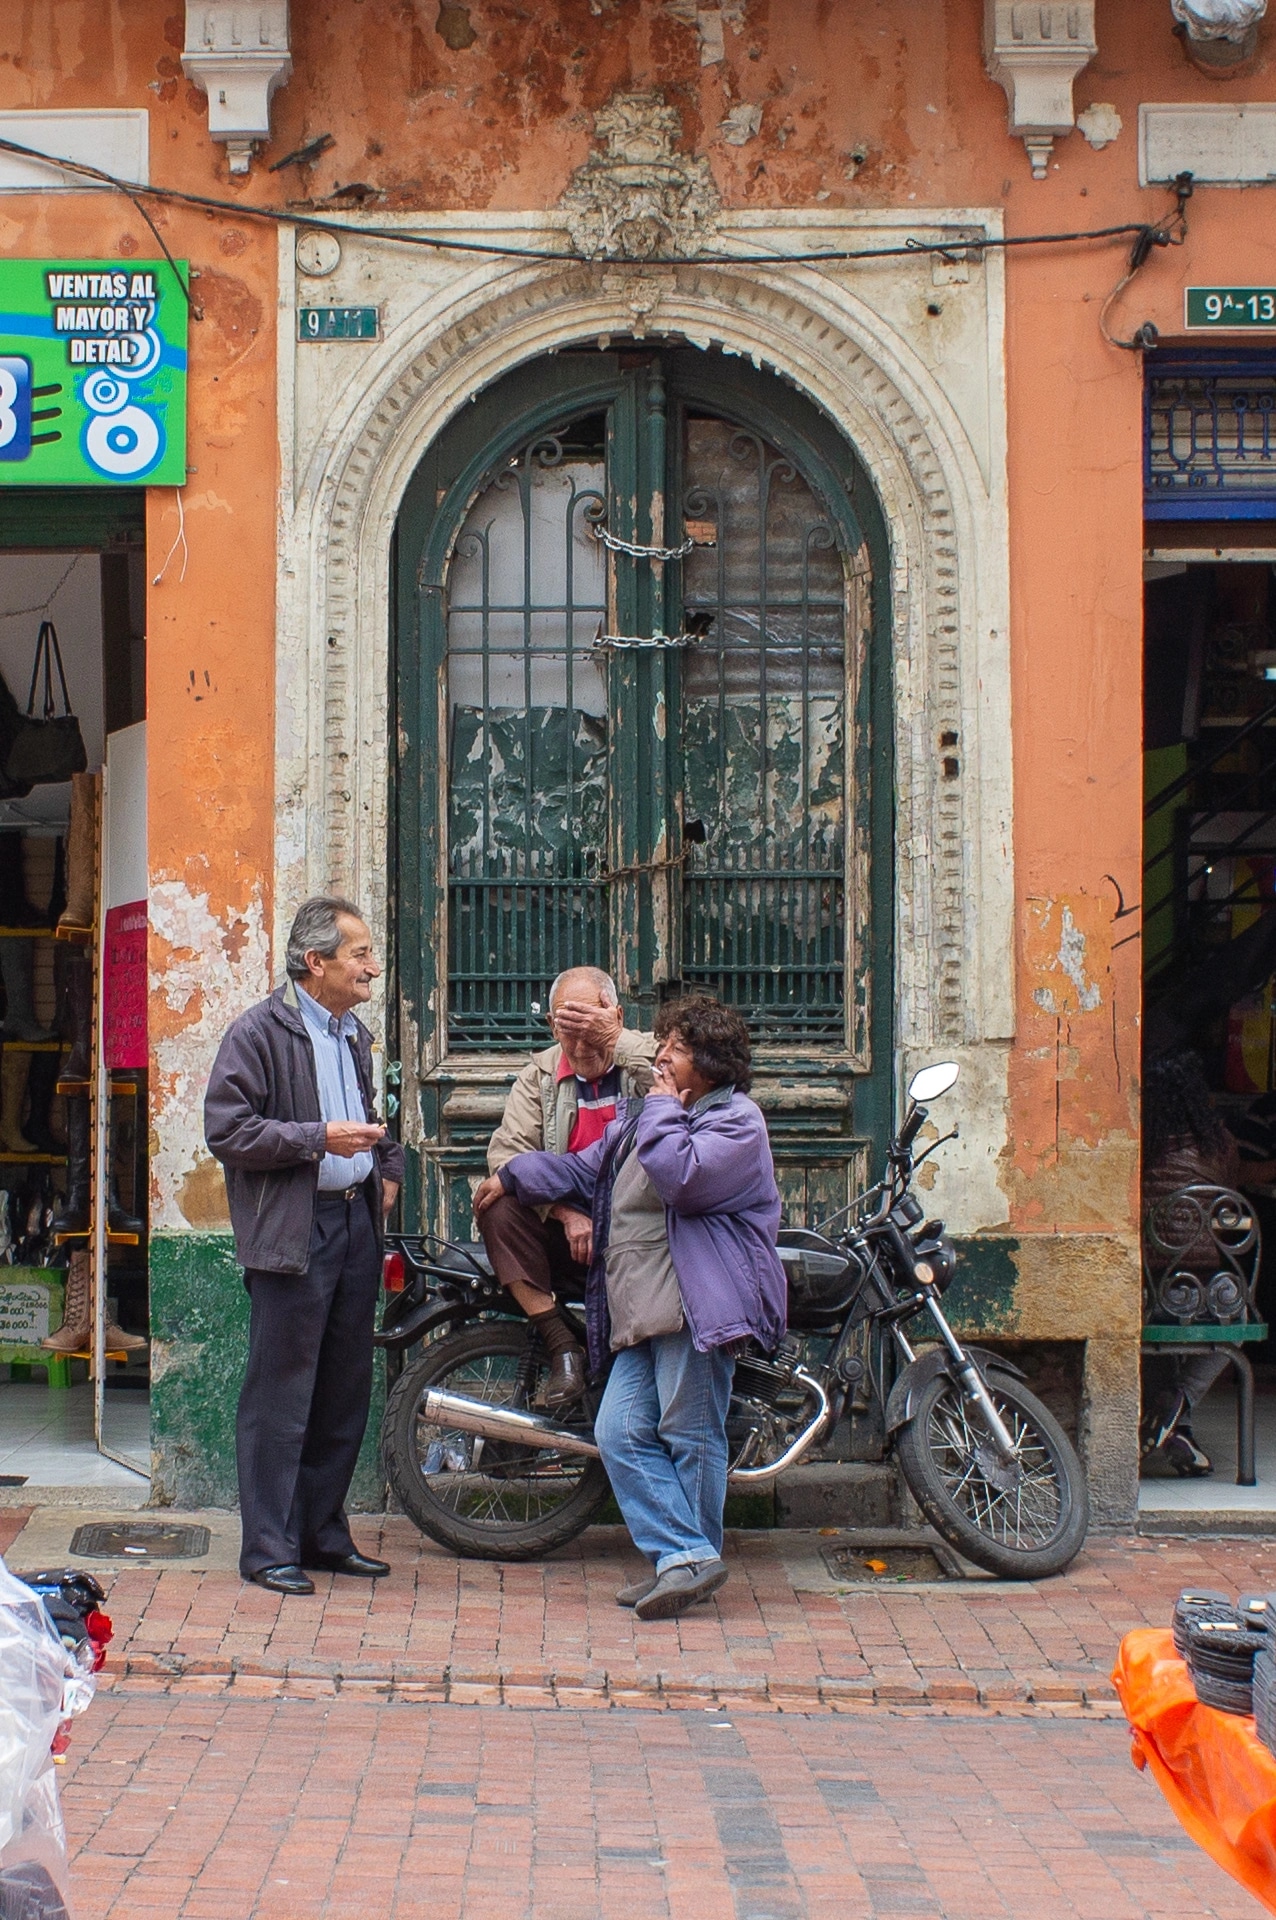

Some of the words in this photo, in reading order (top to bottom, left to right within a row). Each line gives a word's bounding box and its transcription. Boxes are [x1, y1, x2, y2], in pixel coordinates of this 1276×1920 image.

[48, 274, 127, 299] VENTAS
[130, 274, 156, 299] AL
[56, 306, 129, 331] MAYOR
[132, 306, 148, 331] Y
[1204, 293, 1275, 321] 9A-13
[70, 339, 132, 363] DETAL
